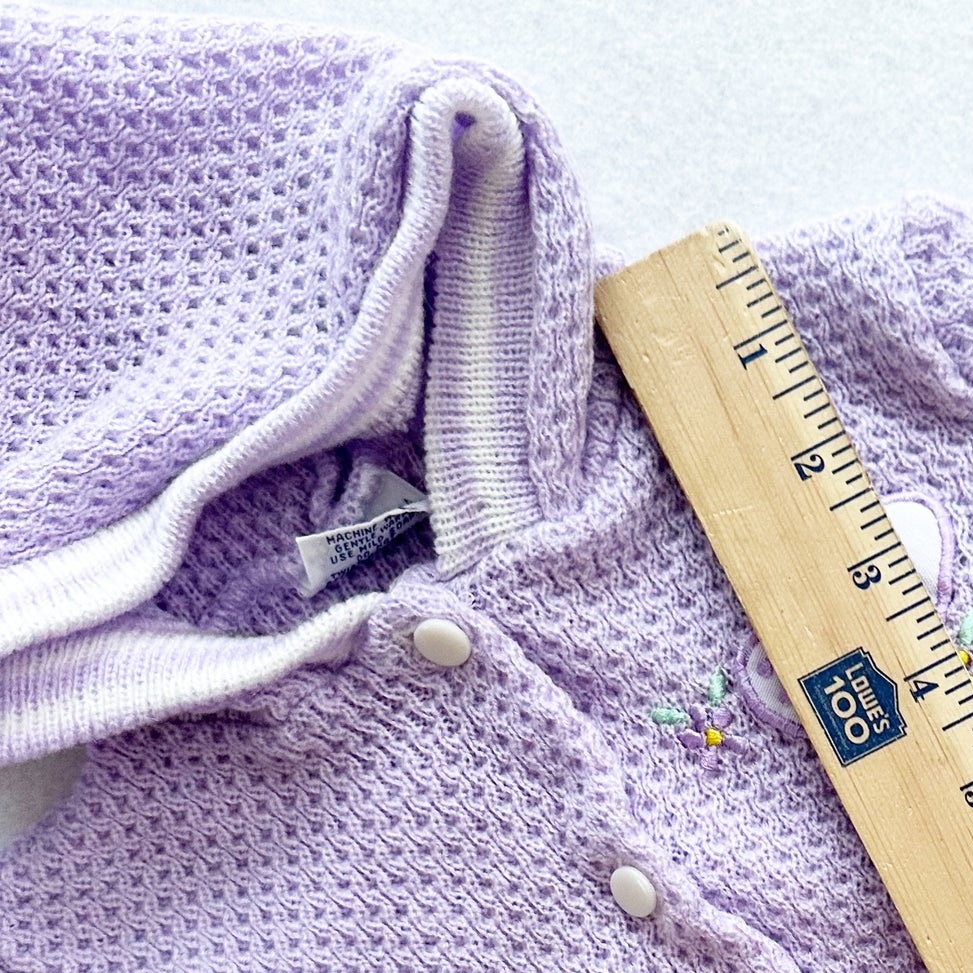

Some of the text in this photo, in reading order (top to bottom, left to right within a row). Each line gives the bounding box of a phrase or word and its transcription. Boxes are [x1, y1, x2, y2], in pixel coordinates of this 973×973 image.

[737, 343, 768, 371] 1
[793, 453, 825, 482] 2
[329, 549, 354, 565] USE
[359, 535, 384, 553] MILD
[334, 532, 377, 554] GENTLE
[852, 564, 882, 591] 3
[844, 662, 891, 734] LOWE'S
[909, 679, 940, 704] 4
[822, 675, 871, 745] 100
